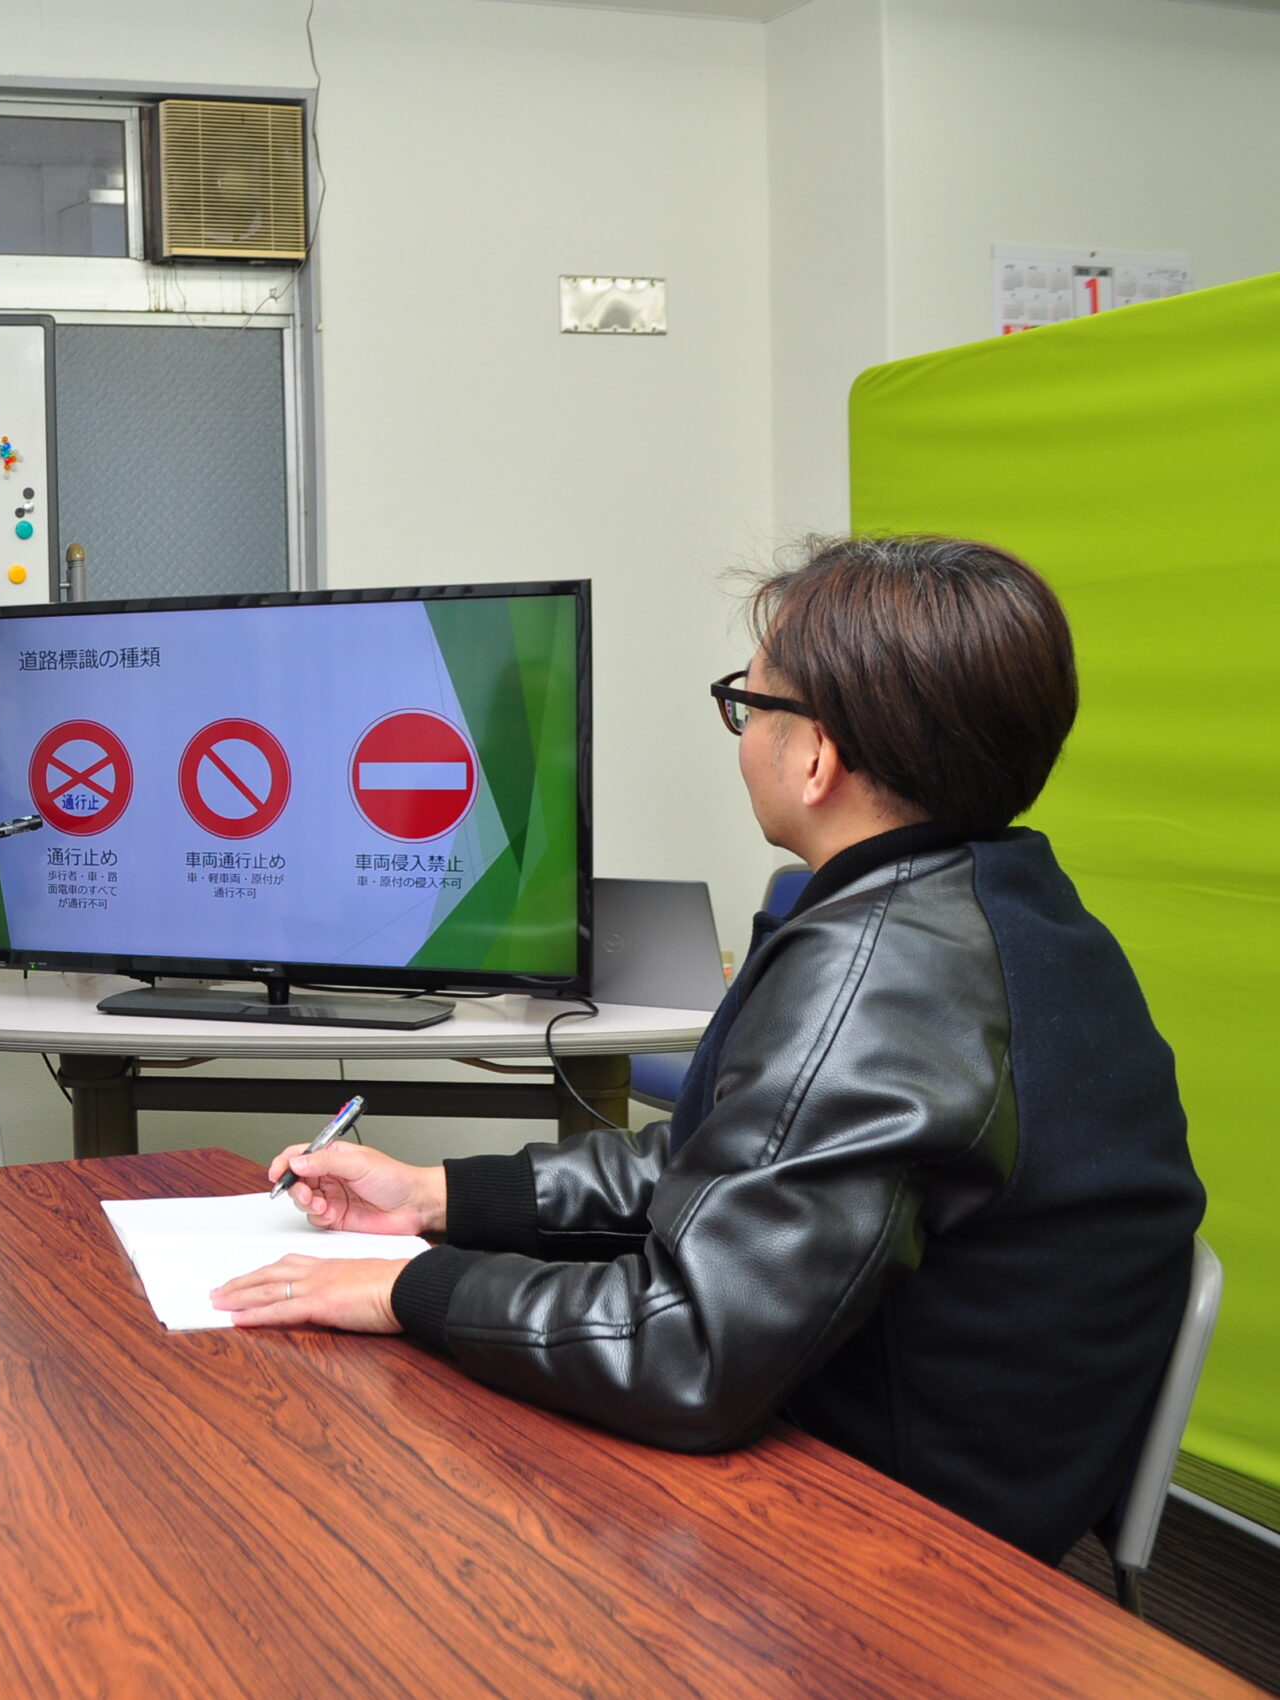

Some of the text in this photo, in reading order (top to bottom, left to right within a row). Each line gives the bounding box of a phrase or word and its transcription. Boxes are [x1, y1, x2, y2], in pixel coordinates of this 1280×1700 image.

[18, 646, 162, 672] 道路標識の種類
[61, 794, 100, 811] 通行止
[46, 847, 119, 867] 通行止め
[185, 851, 287, 870] 車両通行止め
[355, 853, 465, 873] 車両侵入禁止
[47, 870, 119, 883] 歩行者・車・路
[187, 872, 285, 886] 車・軽車両・原付が
[356, 875, 463, 890] 車・原付の侵入不可
[47, 883, 119, 897] 面電車のすべて
[213, 886, 257, 900] 通行不可
[57, 898, 109, 910] が通行不可
